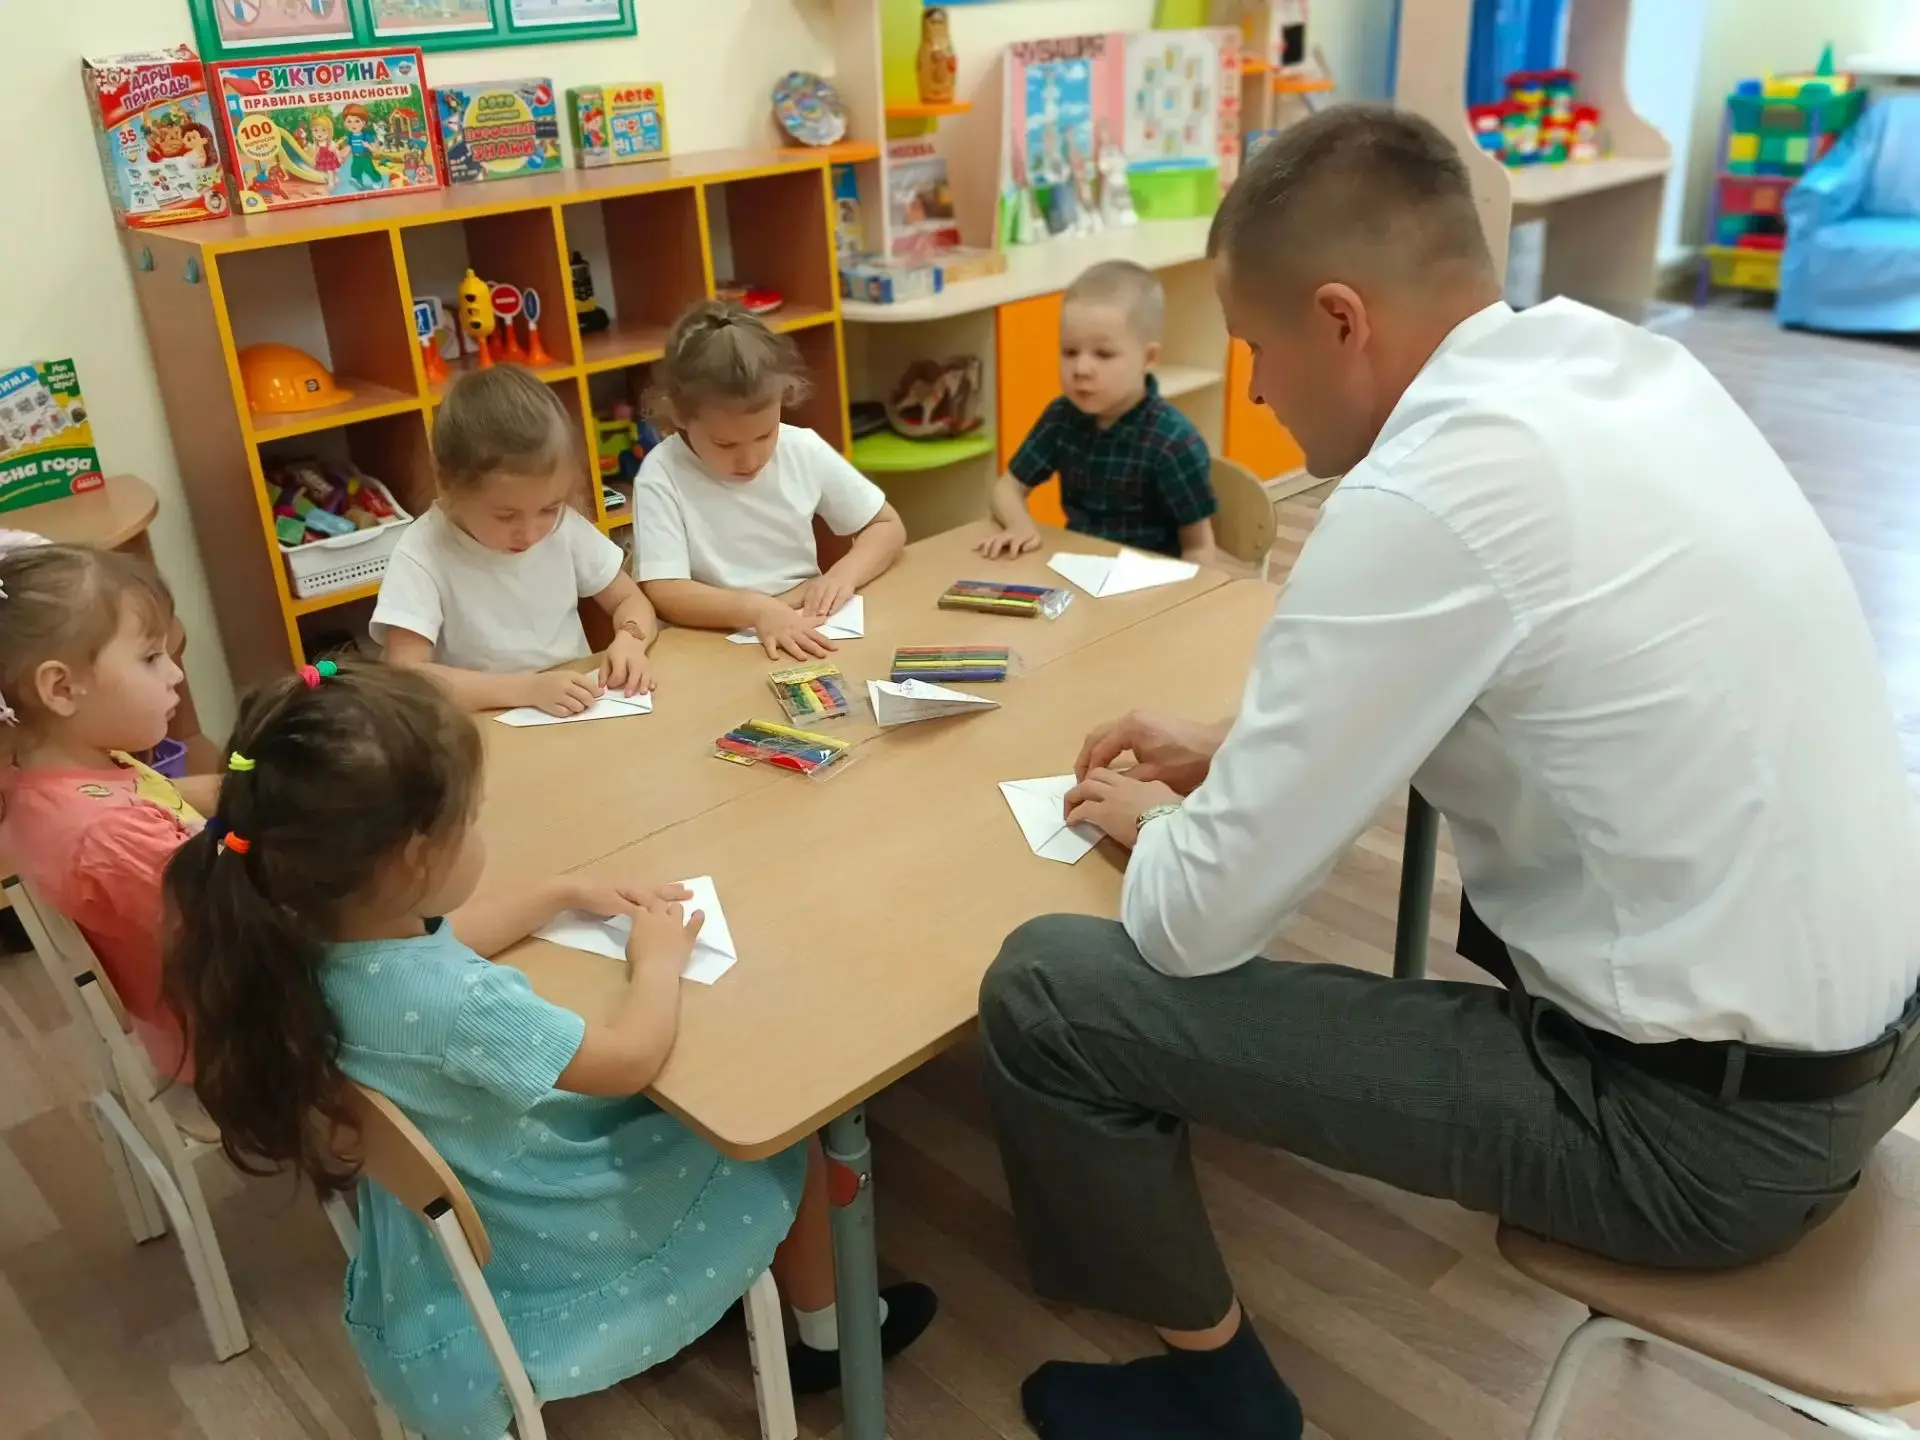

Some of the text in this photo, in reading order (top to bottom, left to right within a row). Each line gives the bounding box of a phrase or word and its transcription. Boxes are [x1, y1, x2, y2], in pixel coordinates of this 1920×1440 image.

[131, 64, 172, 92] ДАРЫ
[257, 60, 390, 90] ВИКТОРИНА
[121, 77, 192, 111] ПРИРОДЫ
[244, 86, 409, 110] ПРАВИЛА БЕЗОПАСНОСТИ
[614, 88, 655, 103] ЛОТО
[119, 129, 137, 145] 35
[241, 121, 272, 140] 100
[471, 139, 535, 162] ЗНАКИ
[0, 370, 31, 395] ИМА
[41, 457, 92, 476] года
